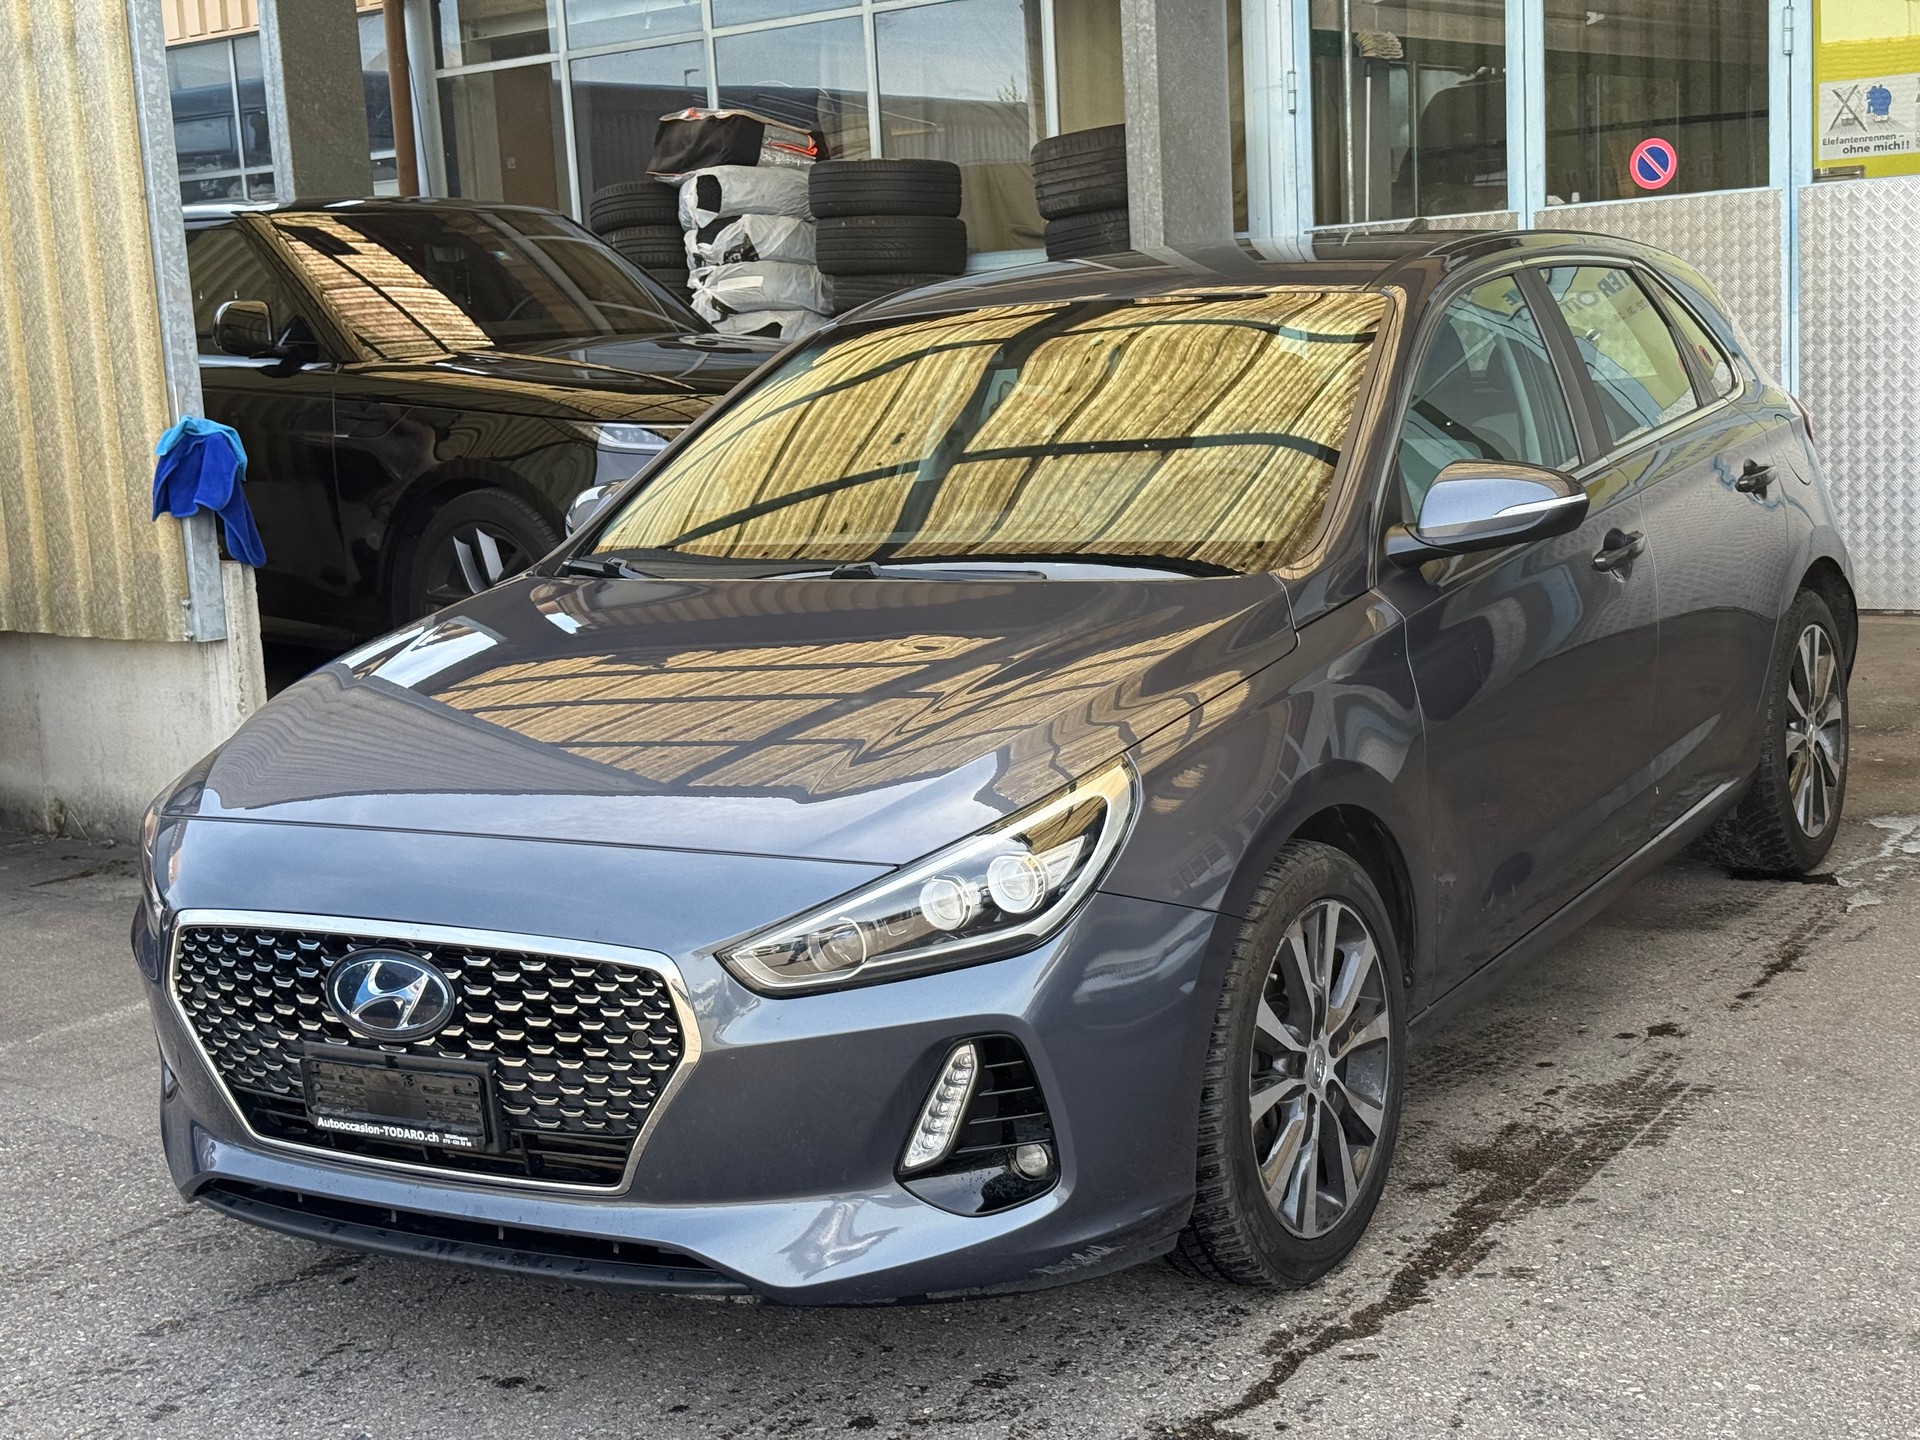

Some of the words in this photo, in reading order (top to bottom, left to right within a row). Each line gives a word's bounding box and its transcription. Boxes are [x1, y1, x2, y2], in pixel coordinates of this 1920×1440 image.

[1822, 133, 1896, 146] Elefantenrennen
[1842, 143, 1871, 155] ohne
[1873, 140, 1910, 152] mich!!
[317, 1116, 439, 1143] Autooccasion-TODARO.ch
